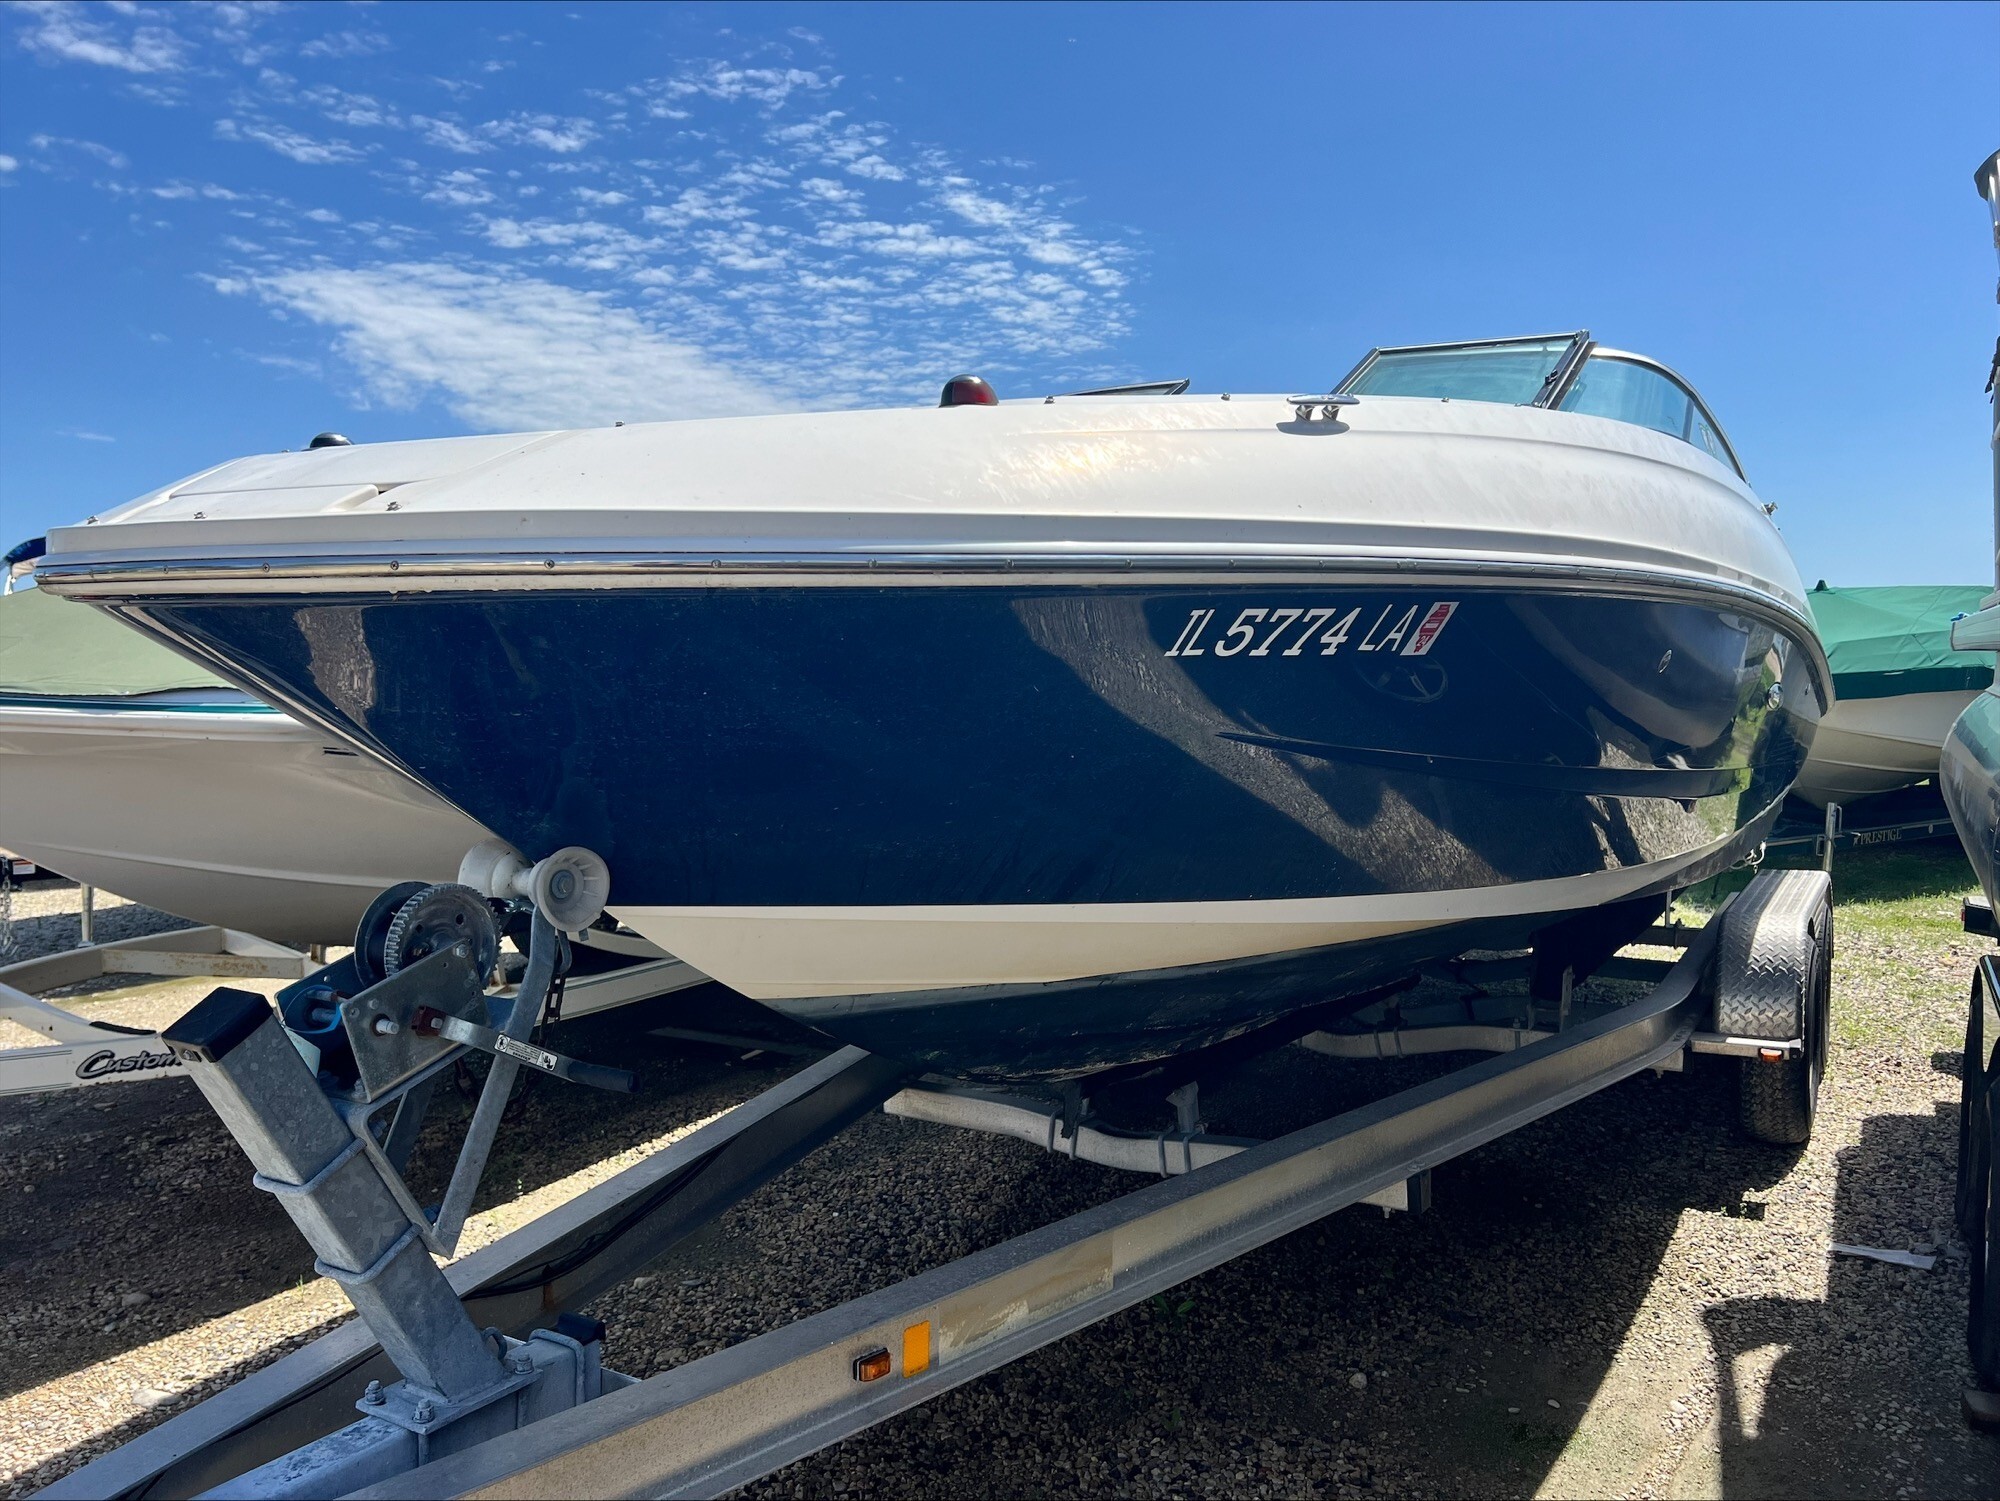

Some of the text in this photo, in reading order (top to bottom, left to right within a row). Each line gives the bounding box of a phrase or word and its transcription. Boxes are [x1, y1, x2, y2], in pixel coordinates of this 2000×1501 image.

[1164, 604, 1418, 657] IL 5774 LA
[1860, 828, 1902, 845] PRESTIGE
[75, 1049, 183, 1080] Custom
